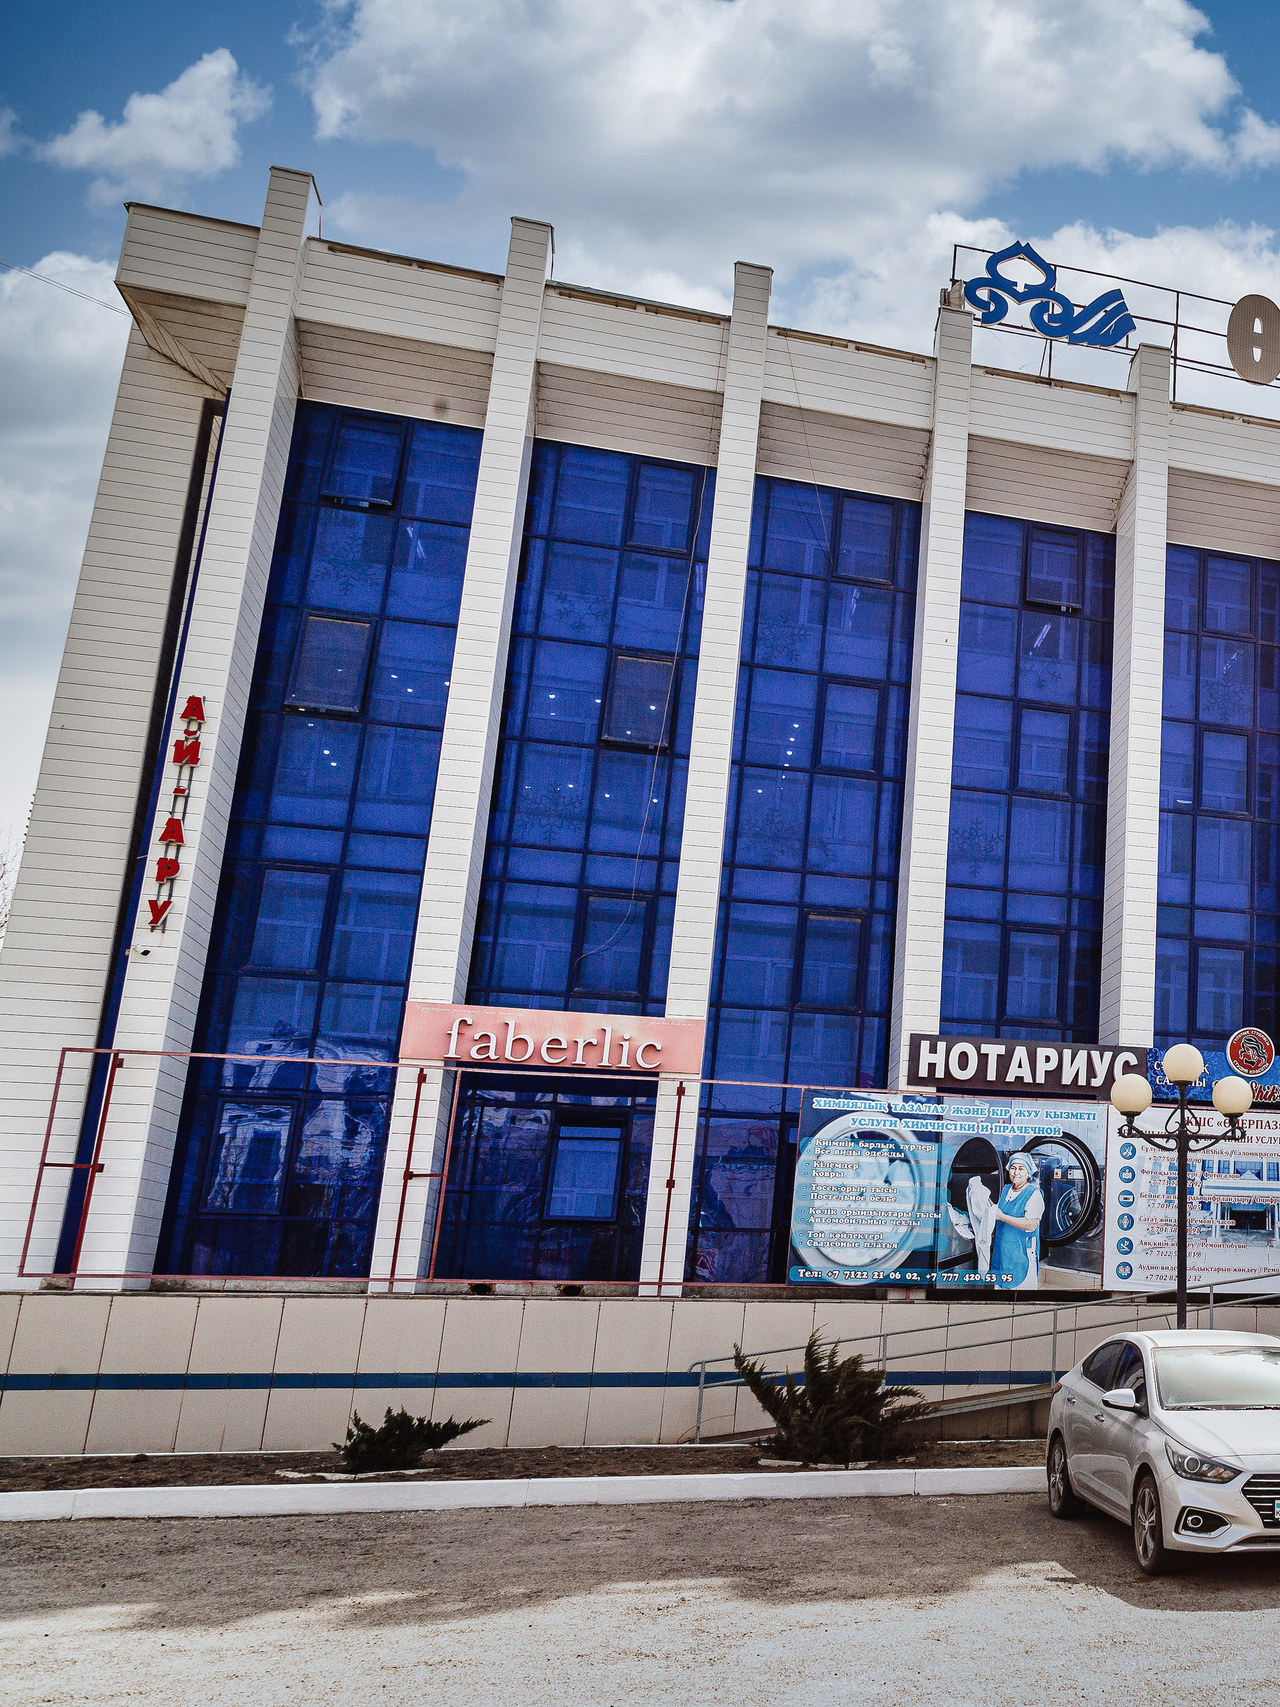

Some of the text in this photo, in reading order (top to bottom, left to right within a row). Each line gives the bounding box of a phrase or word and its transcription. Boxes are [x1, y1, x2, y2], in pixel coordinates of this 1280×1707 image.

[443, 1017, 662, 1069] faberlic
[918, 1040, 1138, 1087] НОТАРИУС
[814, 1099, 888, 1112] ХИМИЯЛЫҚ
[892, 1103, 948, 1114] ТАЗАЛАУ
[952, 1106, 987, 1117] ЖӘНЕ
[1015, 1109, 1041, 1119] ЖУУ
[1045, 1111, 1096, 1121] ҚЫЗМЕТІ
[851, 1117, 898, 1128] УСЛУГИ
[980, 1124, 990, 1133] И
[993, 1124, 1062, 1136] ПРАЧЕЧНОЙ
[798, 1268, 823, 1278] Тел:
[827, 1269, 839, 1279] +7
[843, 1270, 868, 1279] 7122
[872, 1270, 885, 1279] 21
[889, 1271, 901, 1280] 06
[925, 1273, 937, 1281] +7
[941, 1273, 959, 1282] 777
[963, 1273, 981, 1282] 420
[985, 1273, 997, 1282] 53
[1001, 1274, 1013, 1282] 95
